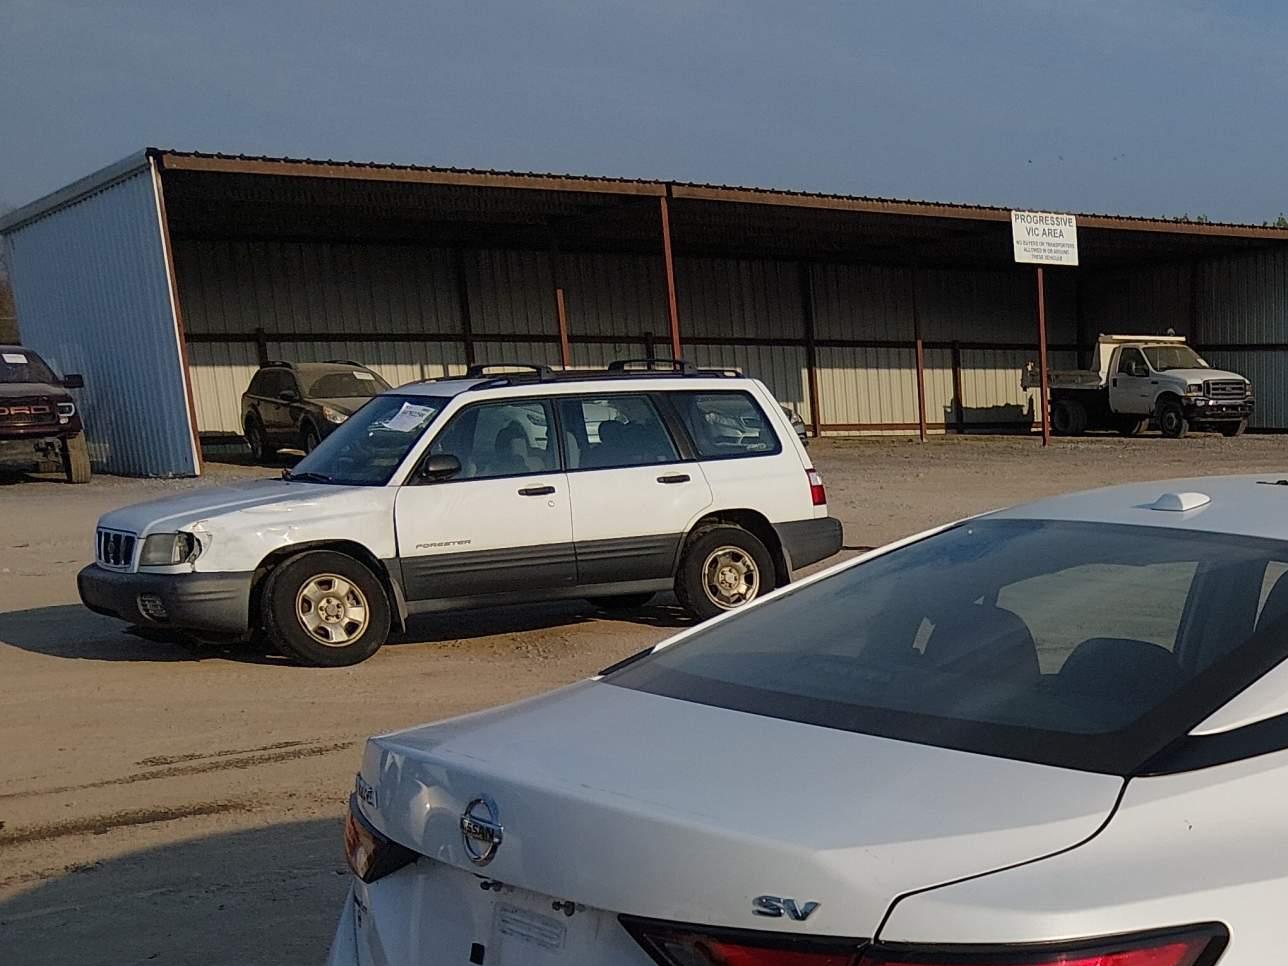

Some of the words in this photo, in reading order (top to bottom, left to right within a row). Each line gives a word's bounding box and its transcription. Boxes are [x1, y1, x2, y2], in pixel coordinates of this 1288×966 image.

[1014, 214, 1073, 227] PROGRESSIVE
[1025, 226, 1039, 236] VIC
[1042, 228, 1064, 239] AREA
[415, 539, 472, 549] FORESTER
[752, 895, 822, 921] SV
